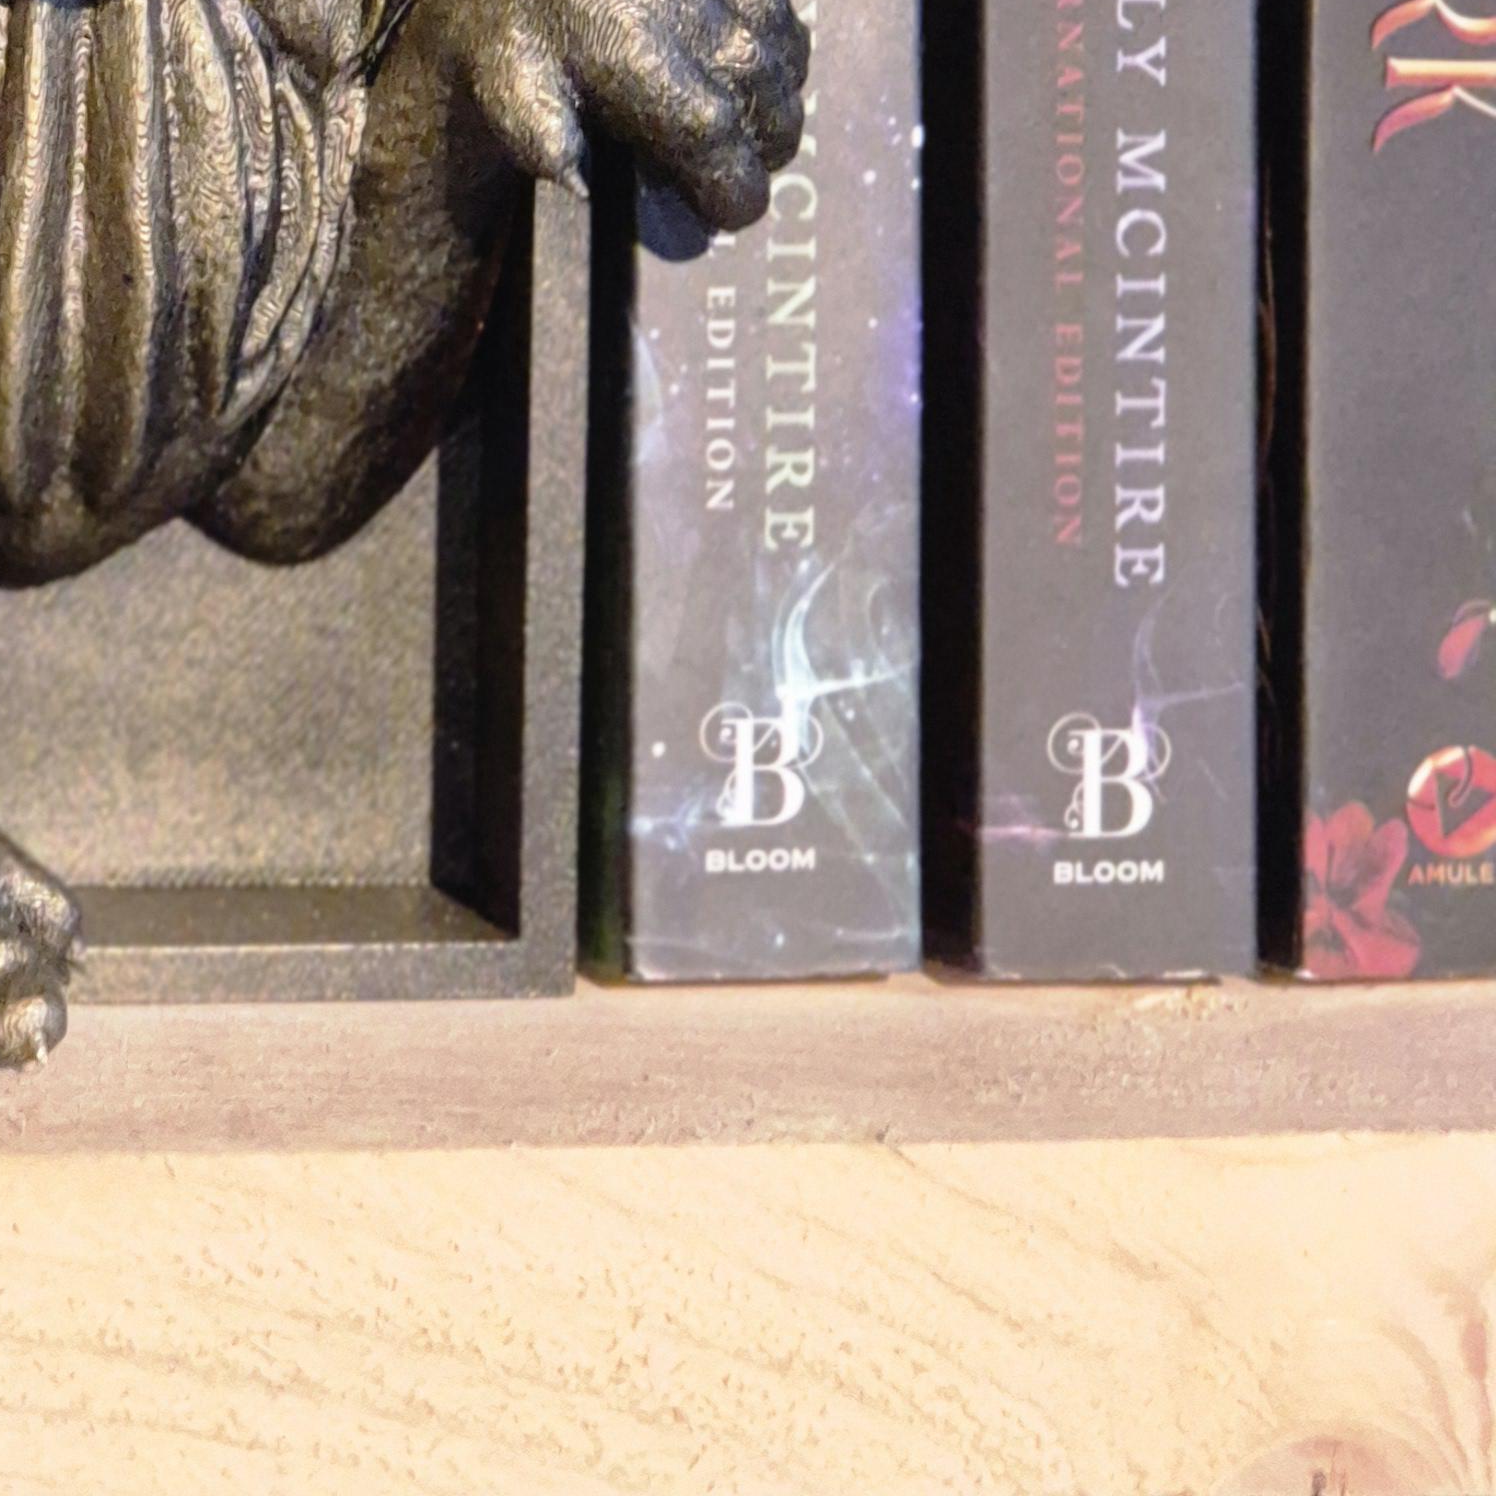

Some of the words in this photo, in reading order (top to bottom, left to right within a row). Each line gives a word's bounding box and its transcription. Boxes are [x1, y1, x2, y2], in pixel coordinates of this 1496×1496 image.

[706, 286, 737, 512] EDITION
[765, 89, 818, 551] CINTIRE
[1113, 128, 1168, 588] MCINTIRE
[1054, 323, 1084, 547] EDITION
[705, 848, 816, 872] BLOOM
[1053, 860, 1164, 885] BLOOM
